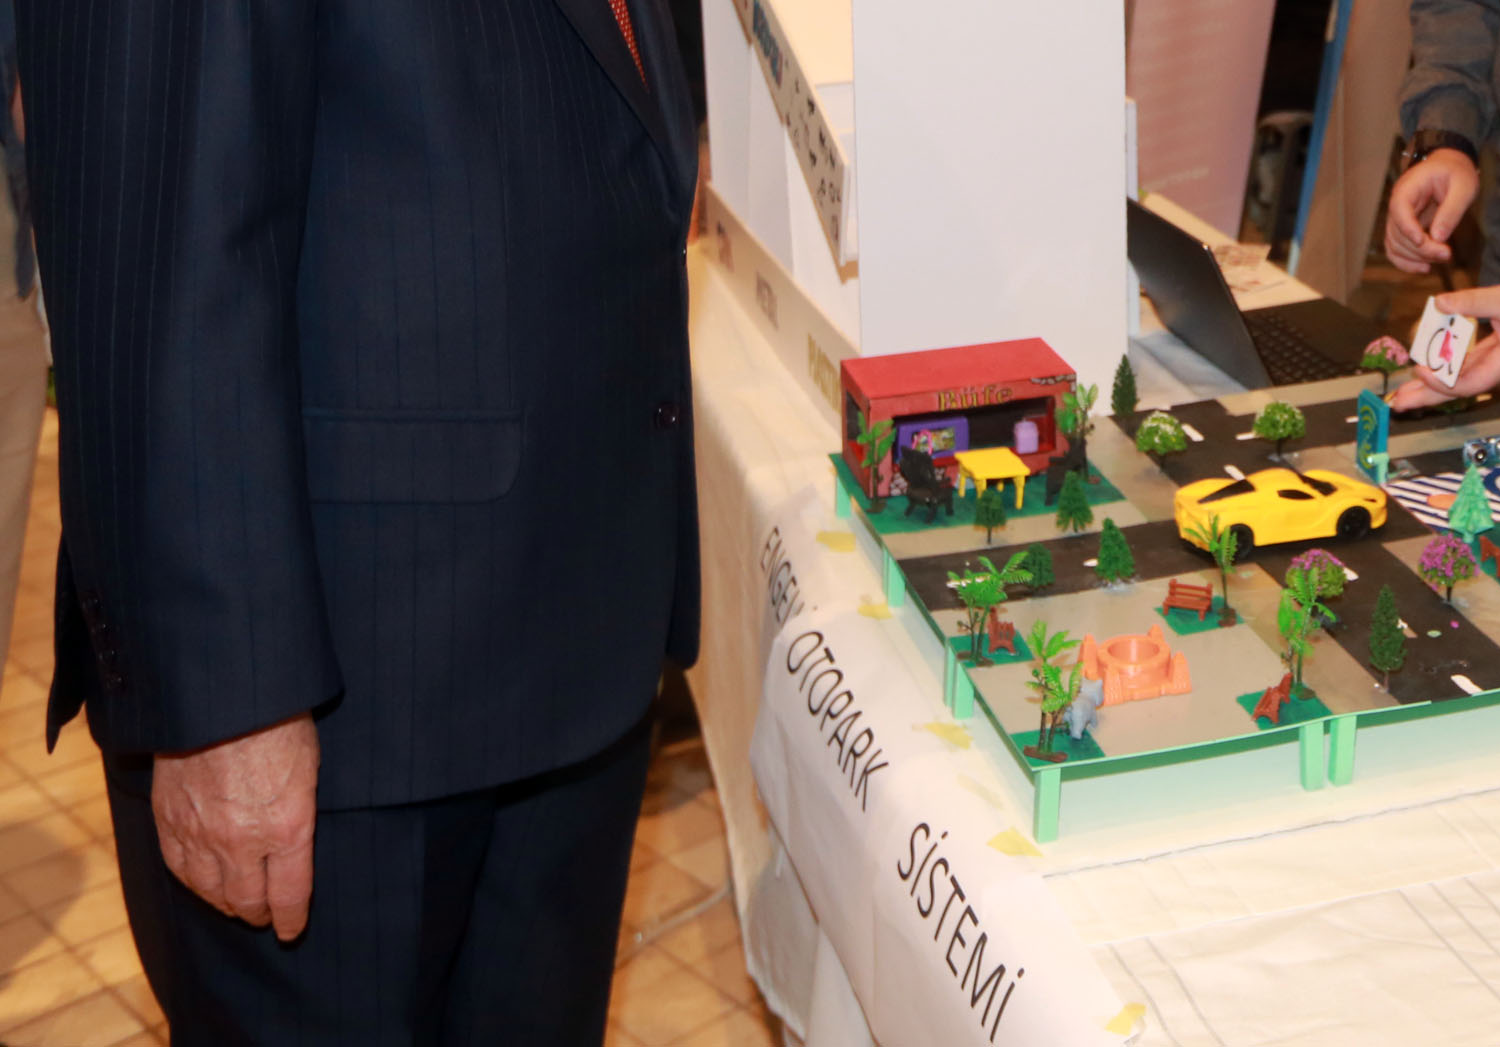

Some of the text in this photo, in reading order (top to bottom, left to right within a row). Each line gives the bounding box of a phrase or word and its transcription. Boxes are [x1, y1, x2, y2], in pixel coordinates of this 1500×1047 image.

[938, 383, 1013, 412] Büfe
[786, 630, 889, 813] OTOPARK
[896, 821, 1026, 1043] SİSTEMİ
